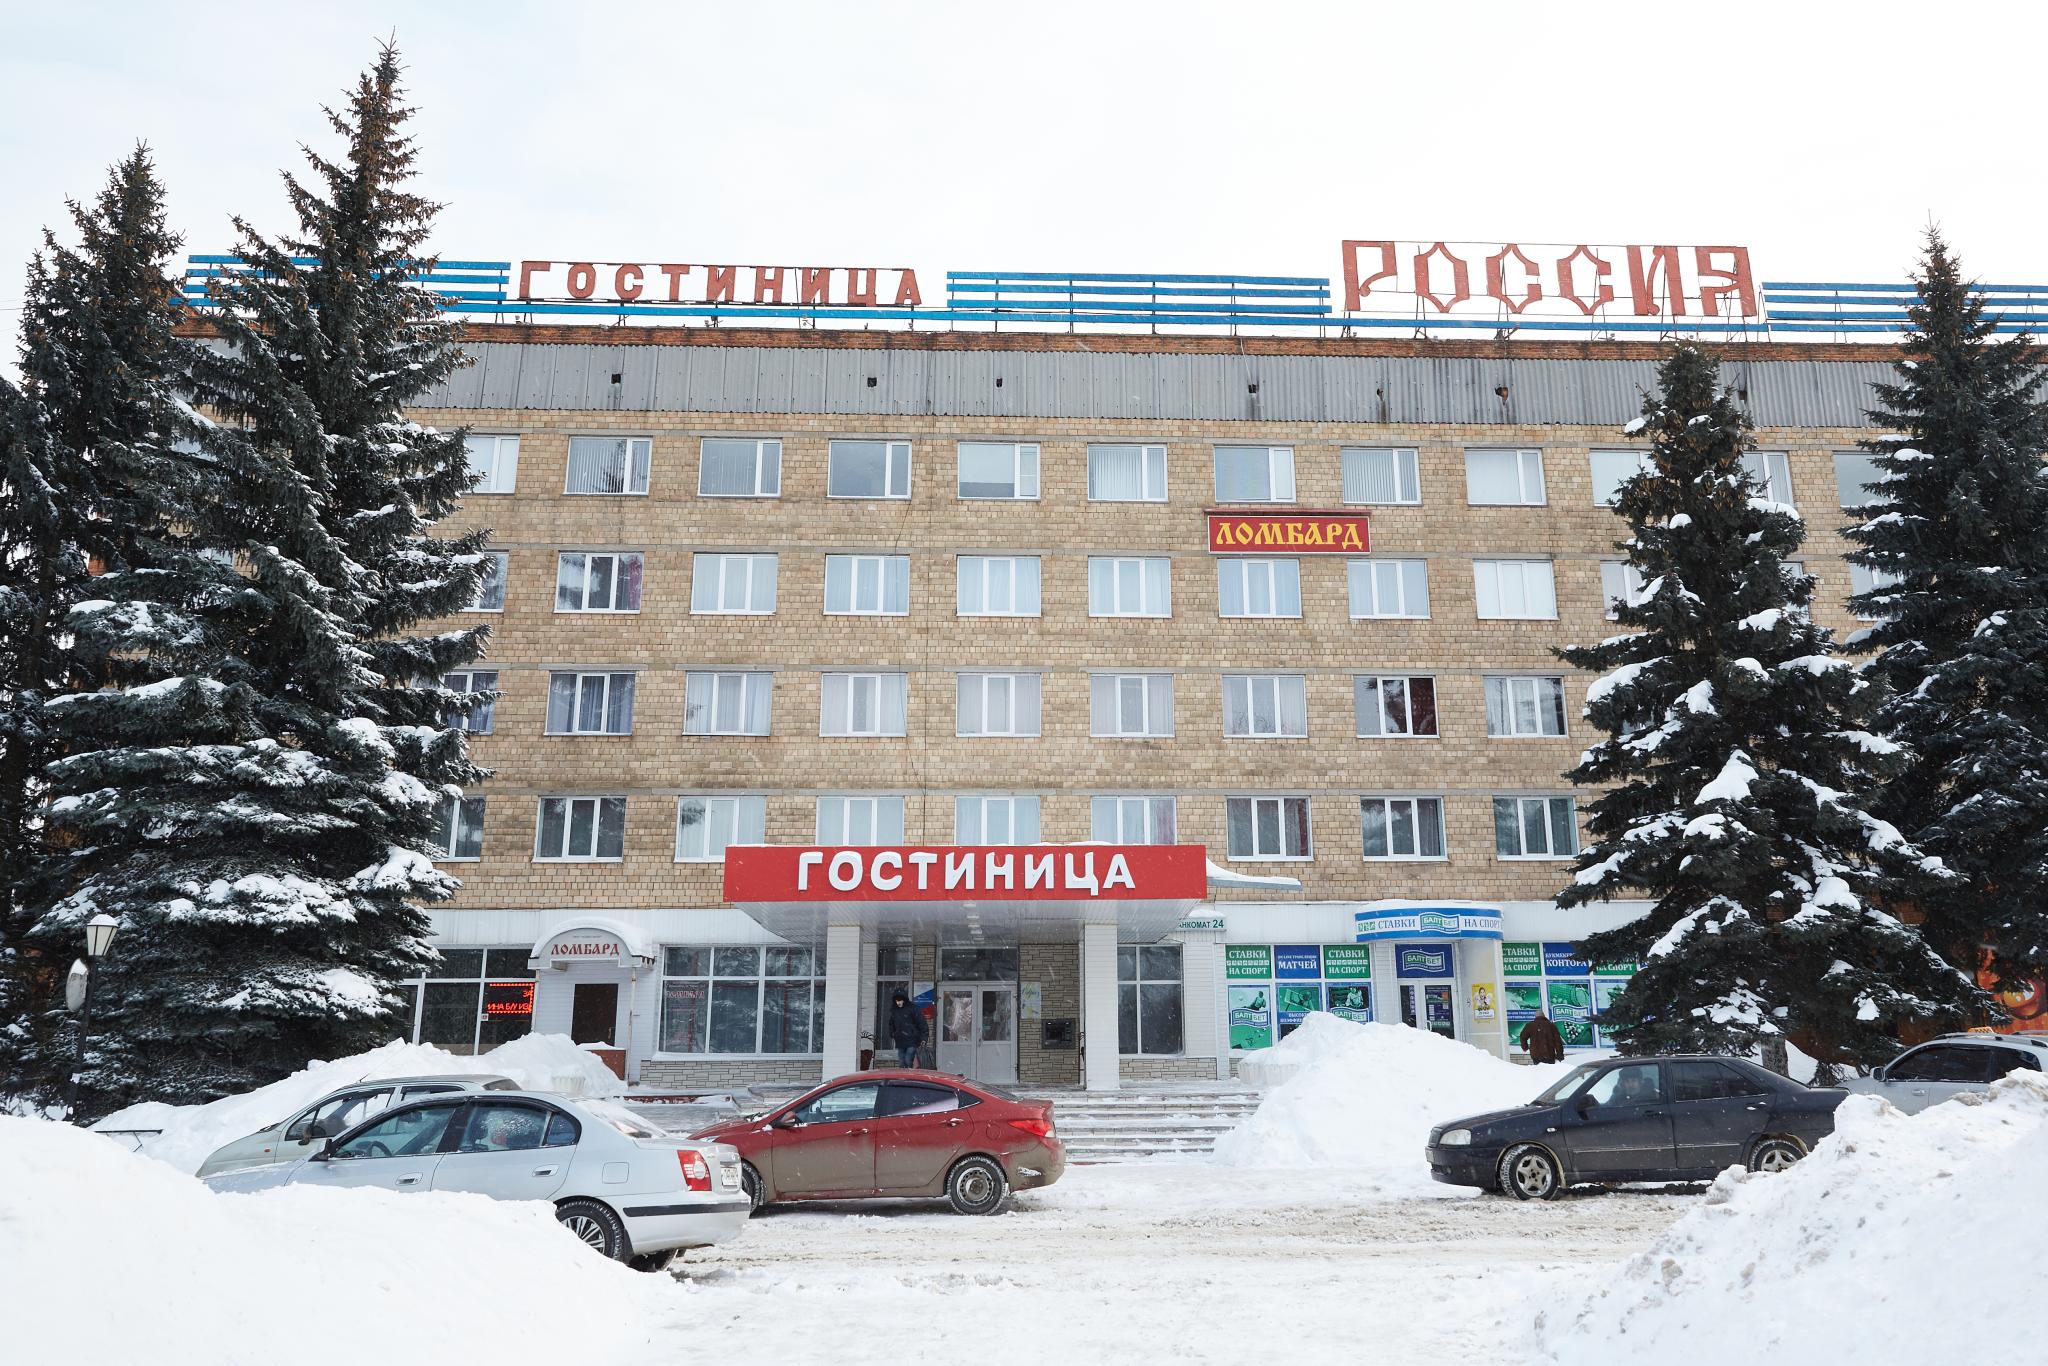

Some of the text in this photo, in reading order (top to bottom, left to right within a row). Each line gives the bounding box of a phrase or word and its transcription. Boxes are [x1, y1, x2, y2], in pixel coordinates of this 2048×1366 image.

[519, 260, 922, 306] ГОСТИНИЦА
[1342, 240, 1758, 316] РОССИЯ
[1216, 521, 1363, 550] ЛОМБАРД
[797, 850, 1136, 897] ГОСТИНИЦА
[1212, 919, 1224, 928] 24
[1378, 919, 1416, 929] СТАВКИ
[1464, 919, 1477, 928] НА
[1479, 919, 1500, 929] СПОРТ
[551, 943, 620, 956] ЛОМБАРД
[1228, 950, 1266, 959] СТАВКИ
[1328, 949, 1365, 958] СТАВКИ
[1278, 959, 1317, 969] МАТЧЕЙ
[1229, 967, 1267, 975] НА СПОРТ
[1328, 966, 1367, 974] НА СПОРТ
